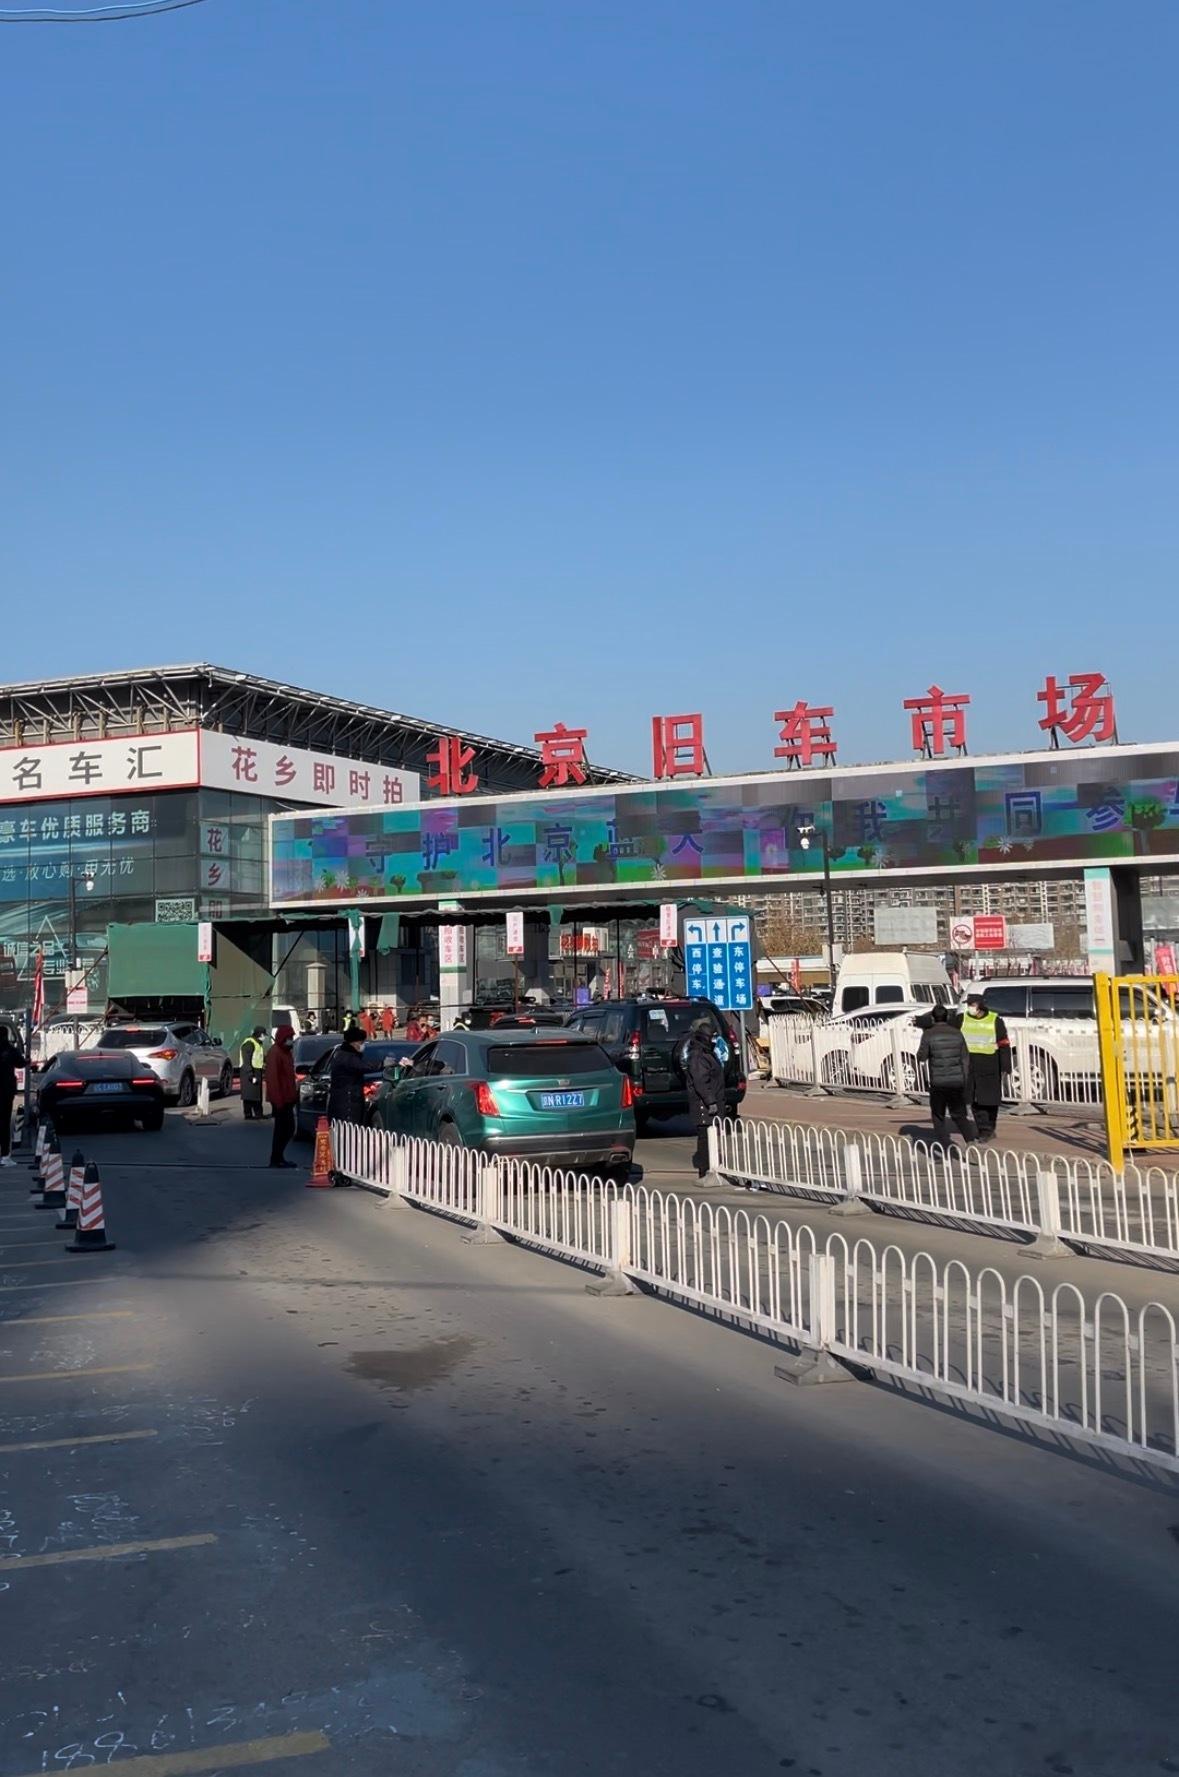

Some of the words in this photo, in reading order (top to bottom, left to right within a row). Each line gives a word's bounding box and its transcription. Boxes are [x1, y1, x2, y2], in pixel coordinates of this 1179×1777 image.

[425, 672, 1114, 795] 北京旧车市场
[12, 746, 162, 790] 名车汇
[232, 746, 403, 804] 花乡即时拍
[0, 810, 150, 843] 豪车优质服务商
[733, 946, 747, 1005] 东停车场
